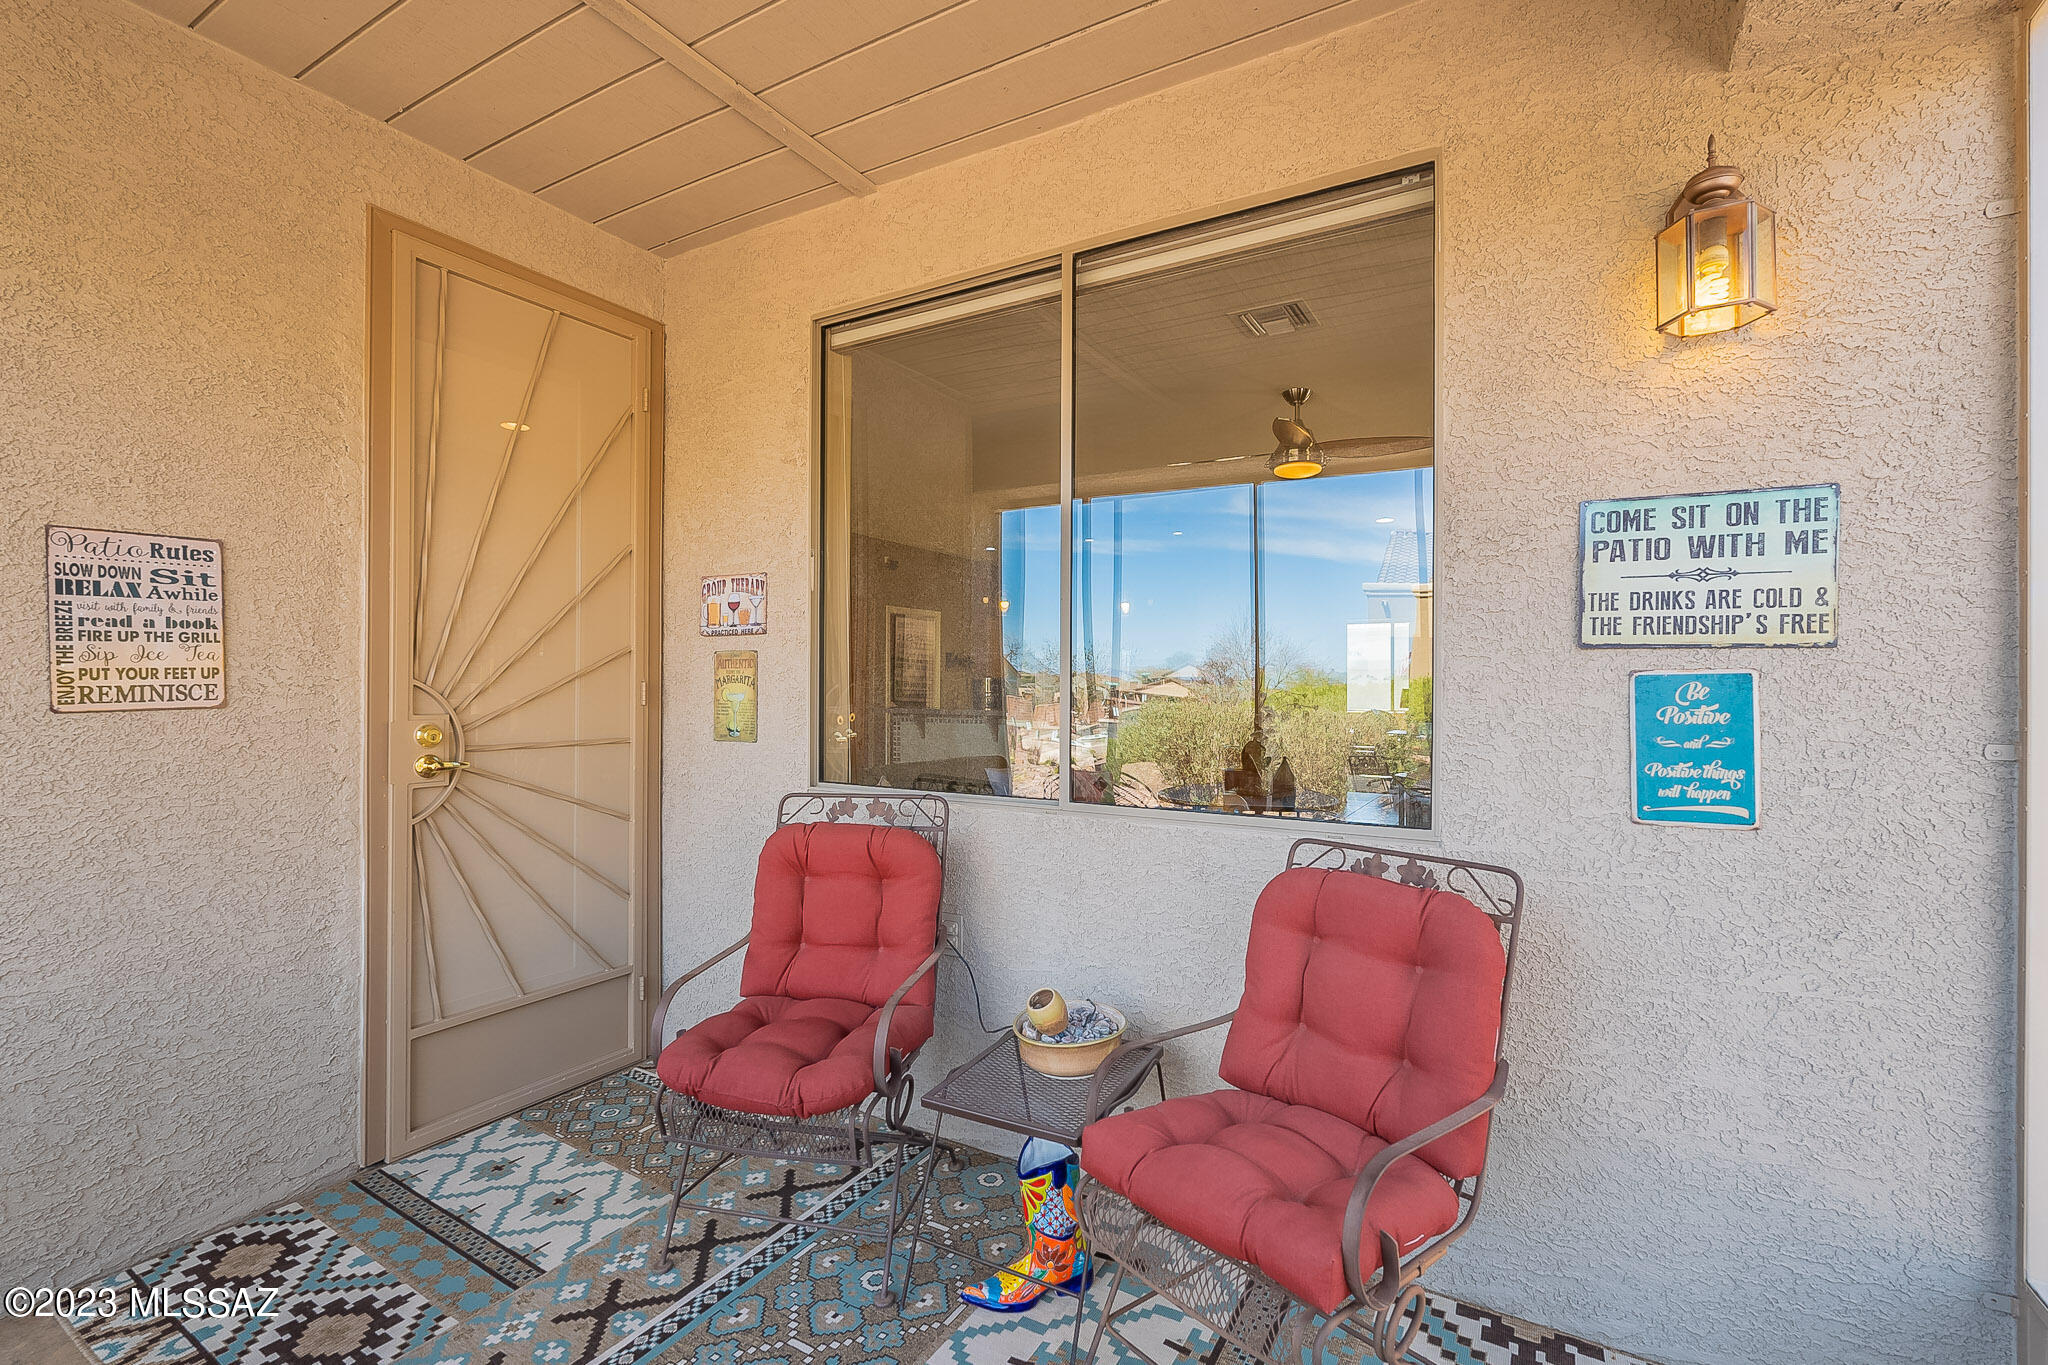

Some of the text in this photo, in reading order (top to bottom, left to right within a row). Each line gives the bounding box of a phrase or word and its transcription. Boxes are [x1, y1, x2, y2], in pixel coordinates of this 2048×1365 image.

[1591, 496, 1829, 534] COME SIT ON THE
[50, 531, 214, 563] Patio Rules
[1592, 528, 1829, 563] PATIO WITH ME
[54, 562, 142, 580] SLOW DOWN
[150, 568, 217, 587] Sit
[55, 578, 142, 599] RELAX
[146, 585, 219, 601] Awhile
[1588, 586, 1829, 612] THE DRINKS ARE COLD &
[77, 602, 218, 616] visit with family & friends
[78, 615, 219, 630] read a book
[1589, 612, 1830, 636] THE FRIENDSHIP'S FREE
[78, 630, 221, 643] FIRE UP THE GRILL
[54, 600, 75, 705] ENJOY THE BREEZE
[78, 643, 220, 666] Sip Ice Tea
[78, 667, 220, 681] PUT YOUR FEET UP
[715, 675, 755, 689] MARGARITA
[77, 684, 219, 704] REMINISCE
[1675, 681, 1711, 706] Be
[1656, 703, 1731, 725] Positive
[1683, 734, 1710, 749] and
[1644, 760, 1746, 790] Positive things
[1658, 782, 1731, 804] will happen
